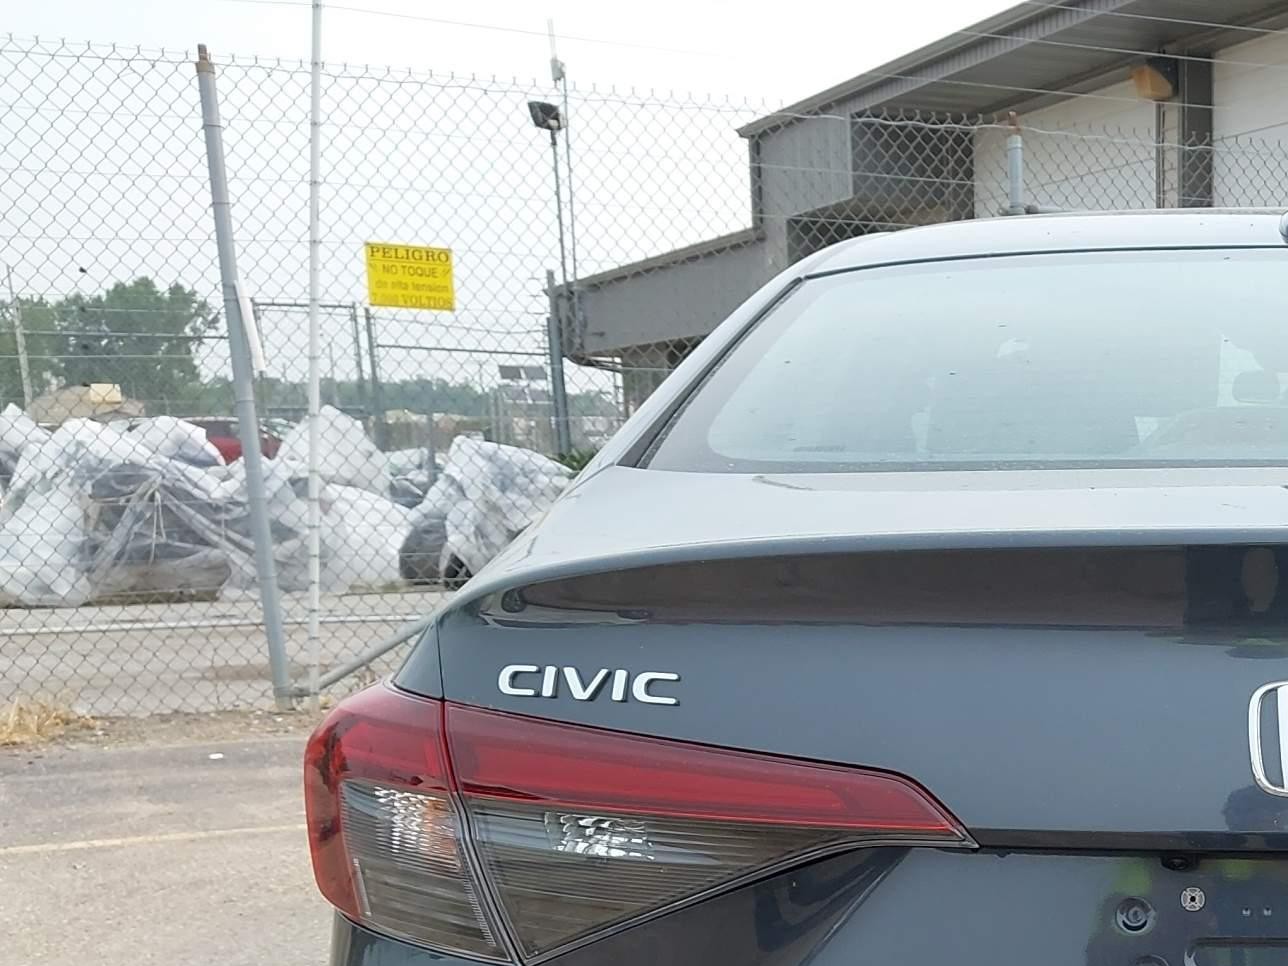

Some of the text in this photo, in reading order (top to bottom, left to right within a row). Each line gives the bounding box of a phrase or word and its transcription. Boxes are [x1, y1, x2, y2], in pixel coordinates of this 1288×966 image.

[370, 246, 450, 263] PELIGRO
[382, 264, 439, 278] NO TOQUE
[498, 664, 679, 705] CIVIC
